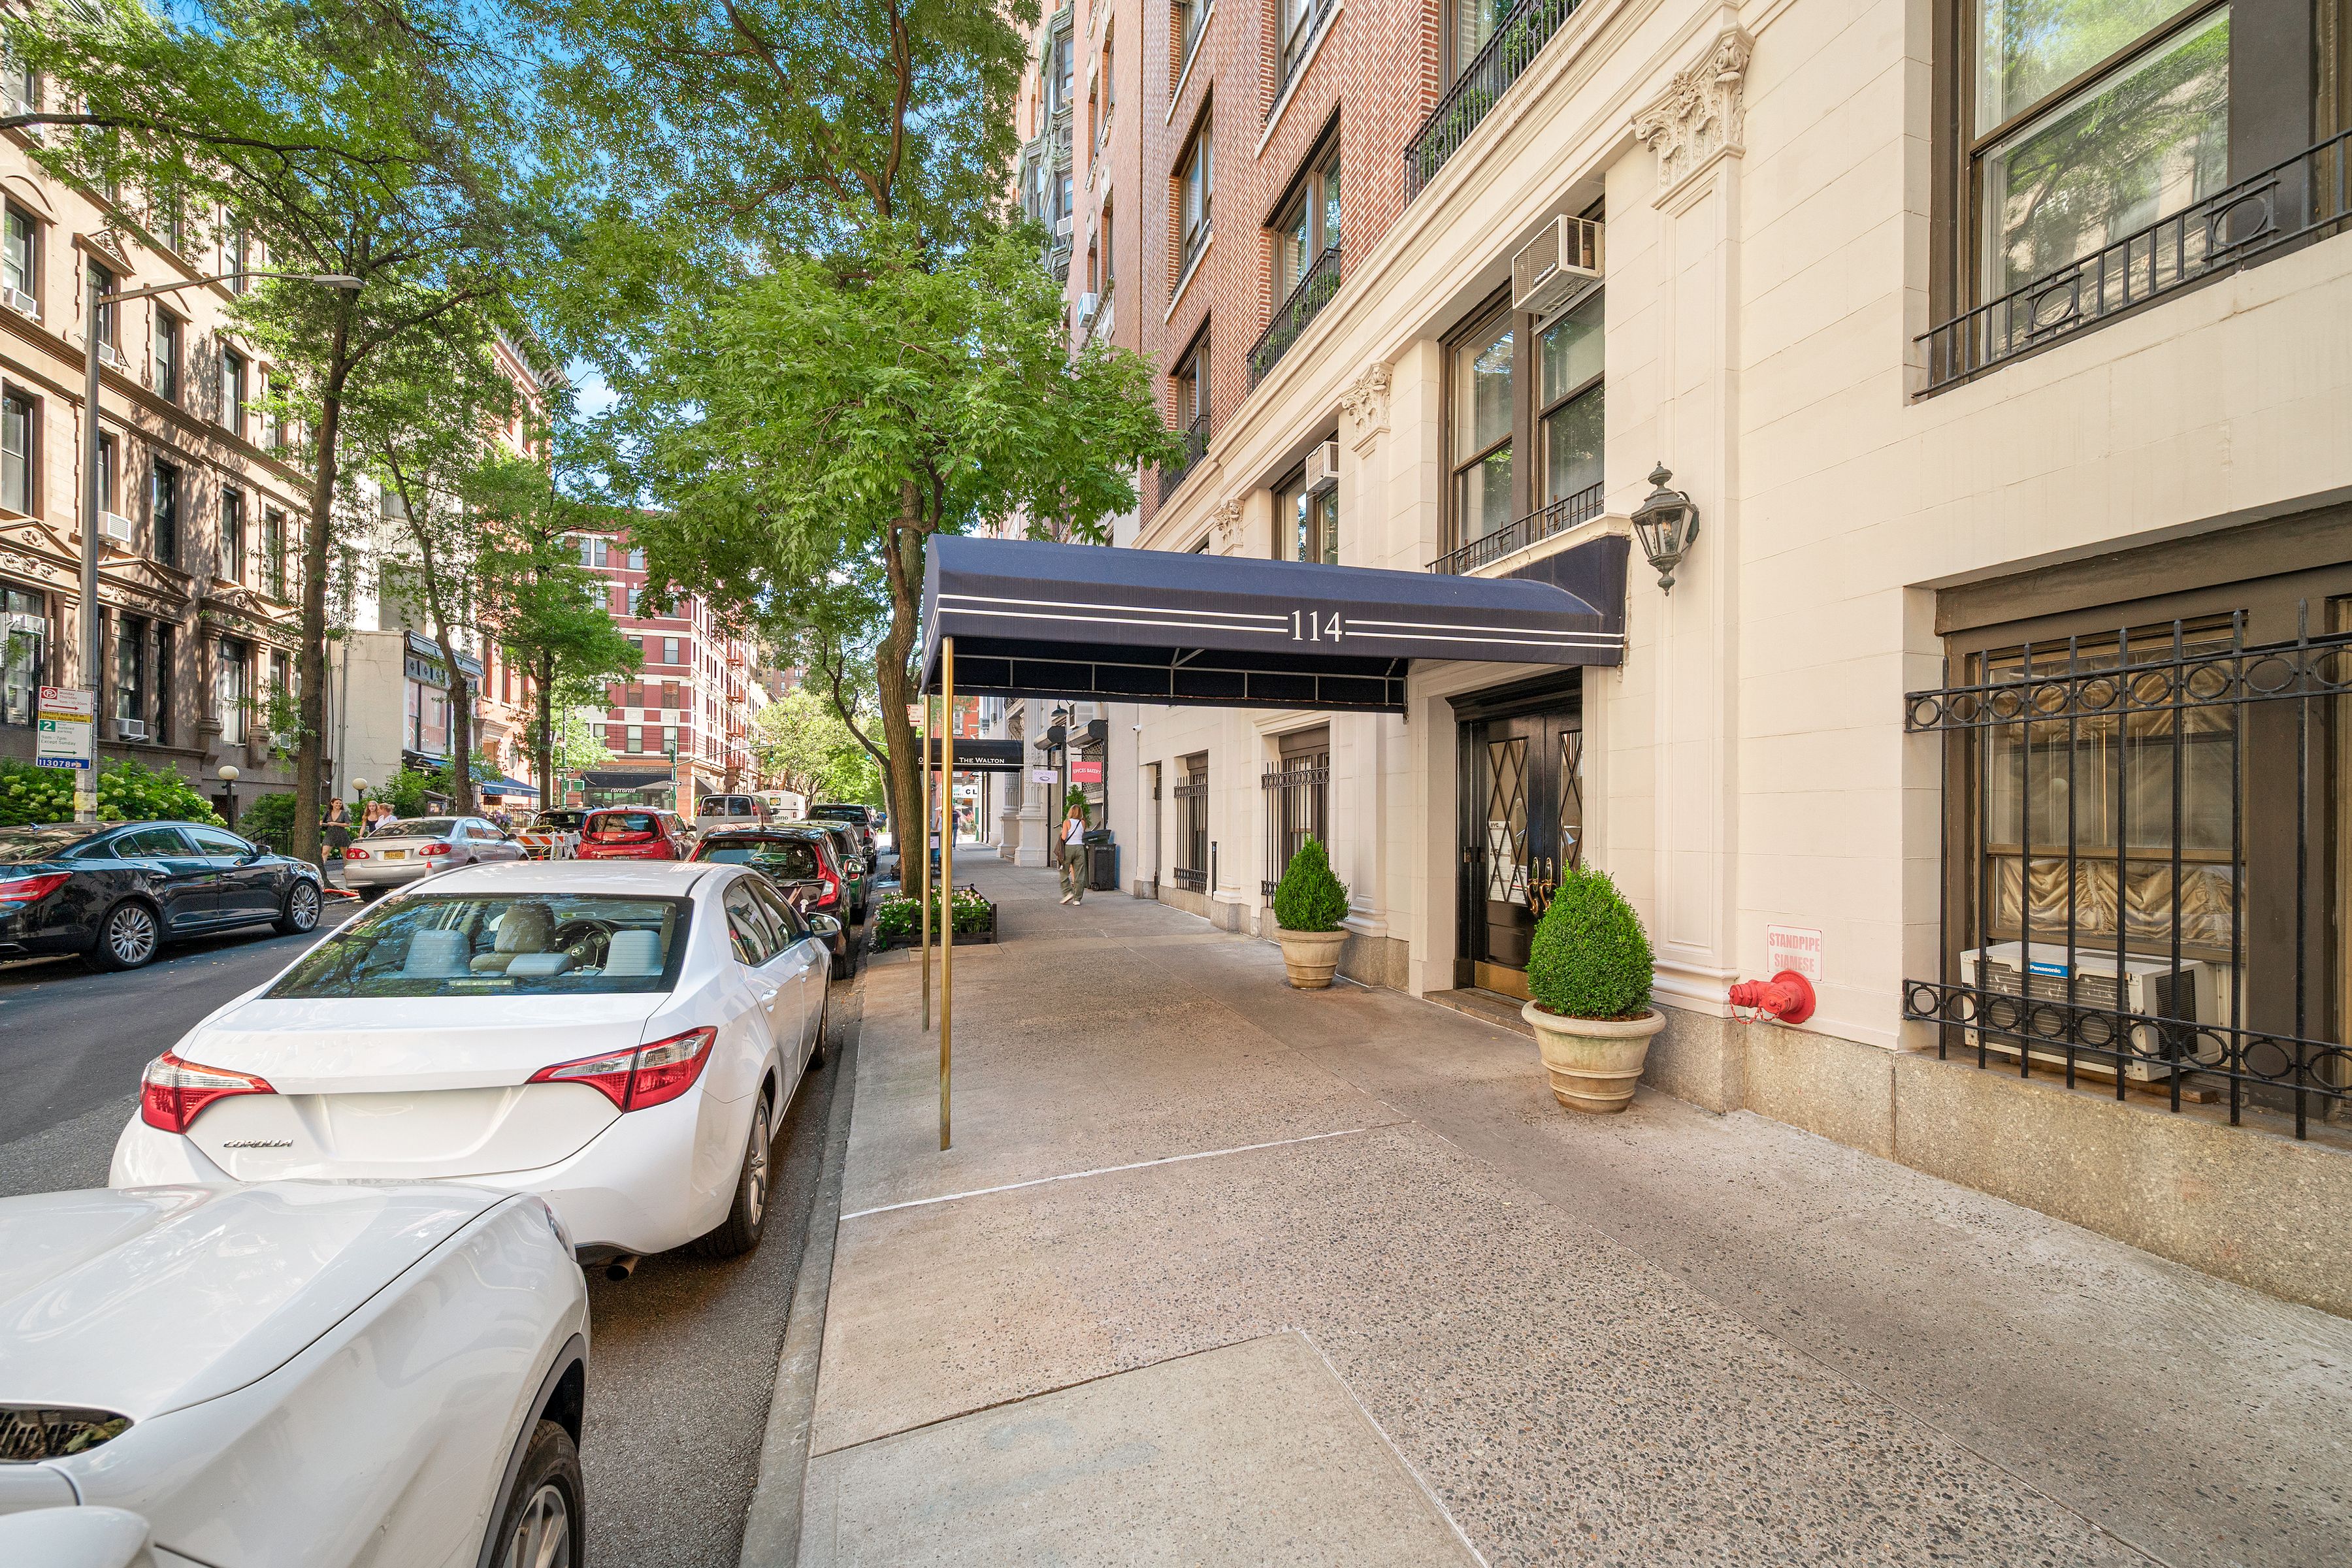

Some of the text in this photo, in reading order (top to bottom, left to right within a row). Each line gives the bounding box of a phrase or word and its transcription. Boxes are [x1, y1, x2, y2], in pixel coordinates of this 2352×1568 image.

[1292, 610, 1343, 642] 114
[43, 721, 52, 731] 2
[39, 759, 71, 768] 113078
[1769, 932, 1820, 952] STANDPIPE
[1774, 953, 1814, 973] SIAMESE
[2029, 964, 2061, 973] Panasonic
[223, 1139, 293, 1148] COROLLA
